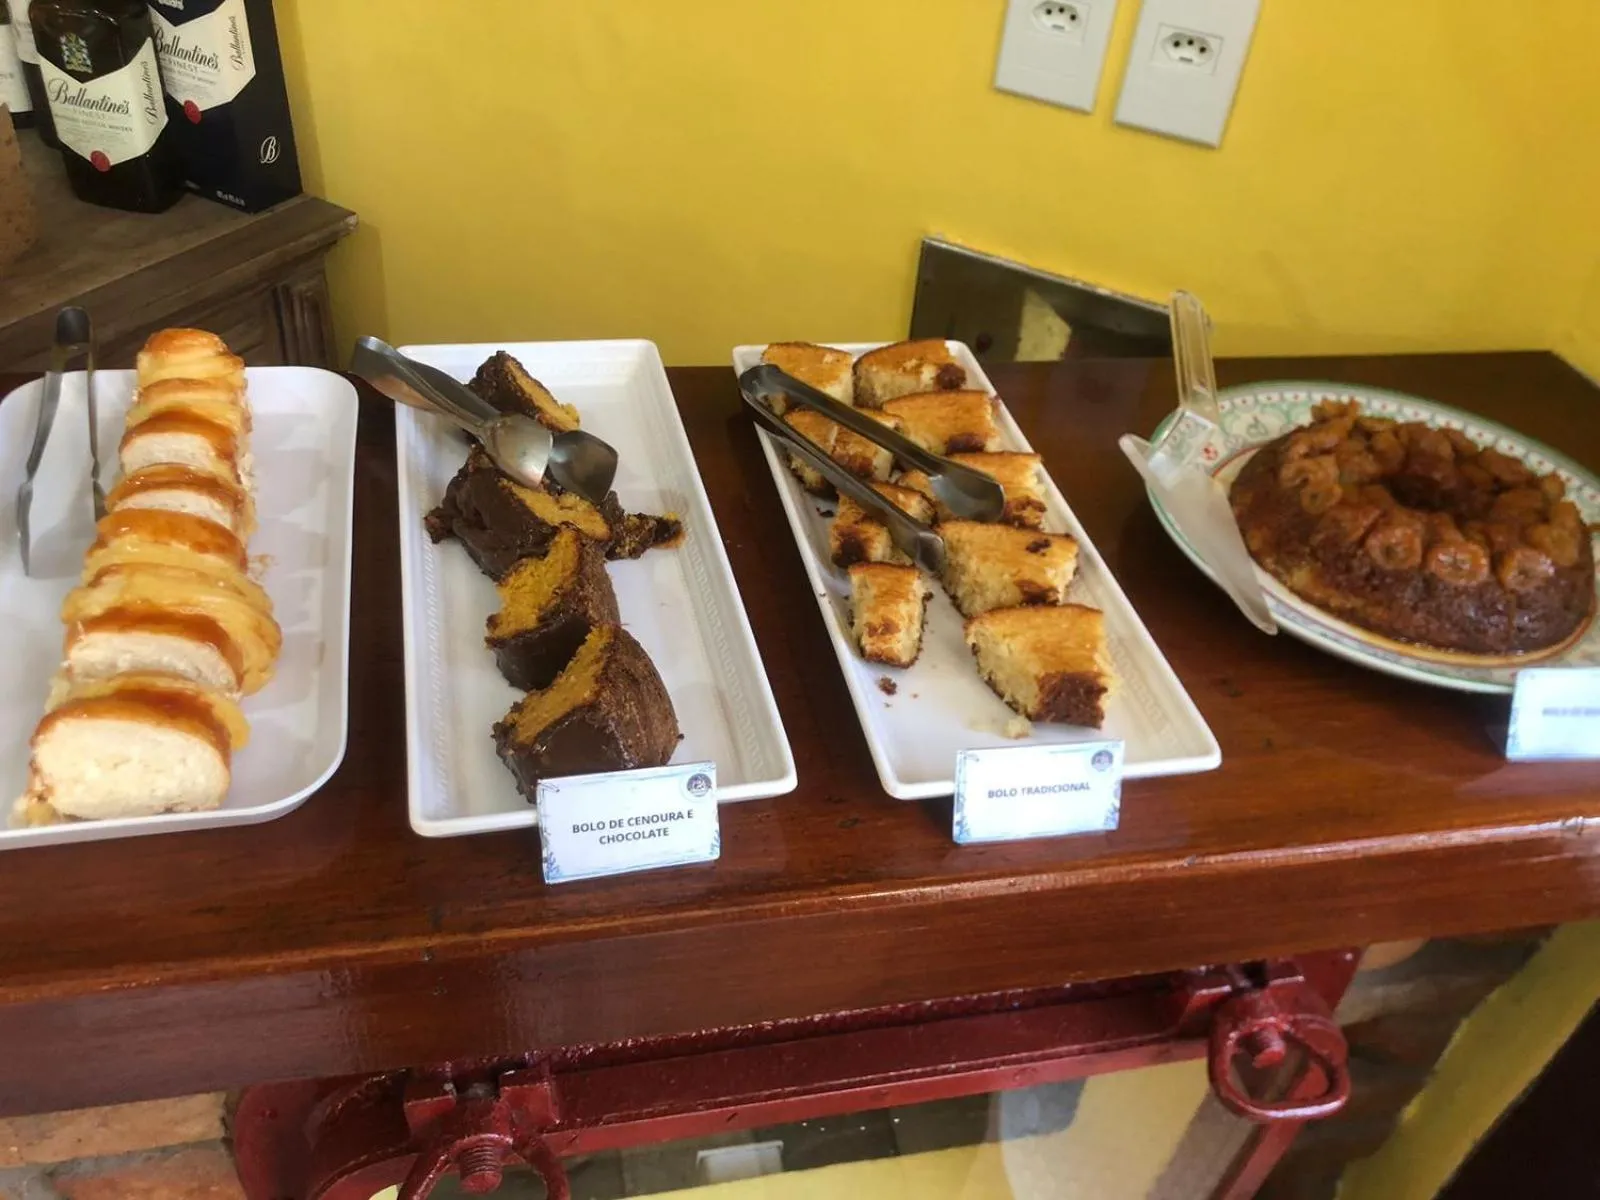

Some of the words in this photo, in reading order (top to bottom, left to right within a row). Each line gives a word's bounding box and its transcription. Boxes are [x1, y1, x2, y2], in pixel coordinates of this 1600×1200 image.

[154, 23, 219, 70] Ballantine's
[48, 78, 130, 115] Ballantine's
[260, 136, 281, 164] B
[987, 788, 1018, 799] BOLO
[1020, 782, 1091, 797] TRADICIONAL
[572, 821, 606, 834] BOLO
[609, 818, 625, 830] DE
[627, 811, 685, 828] CENOURA
[687, 809, 694, 819] E
[598, 827, 670, 845] CHOCOLATE
